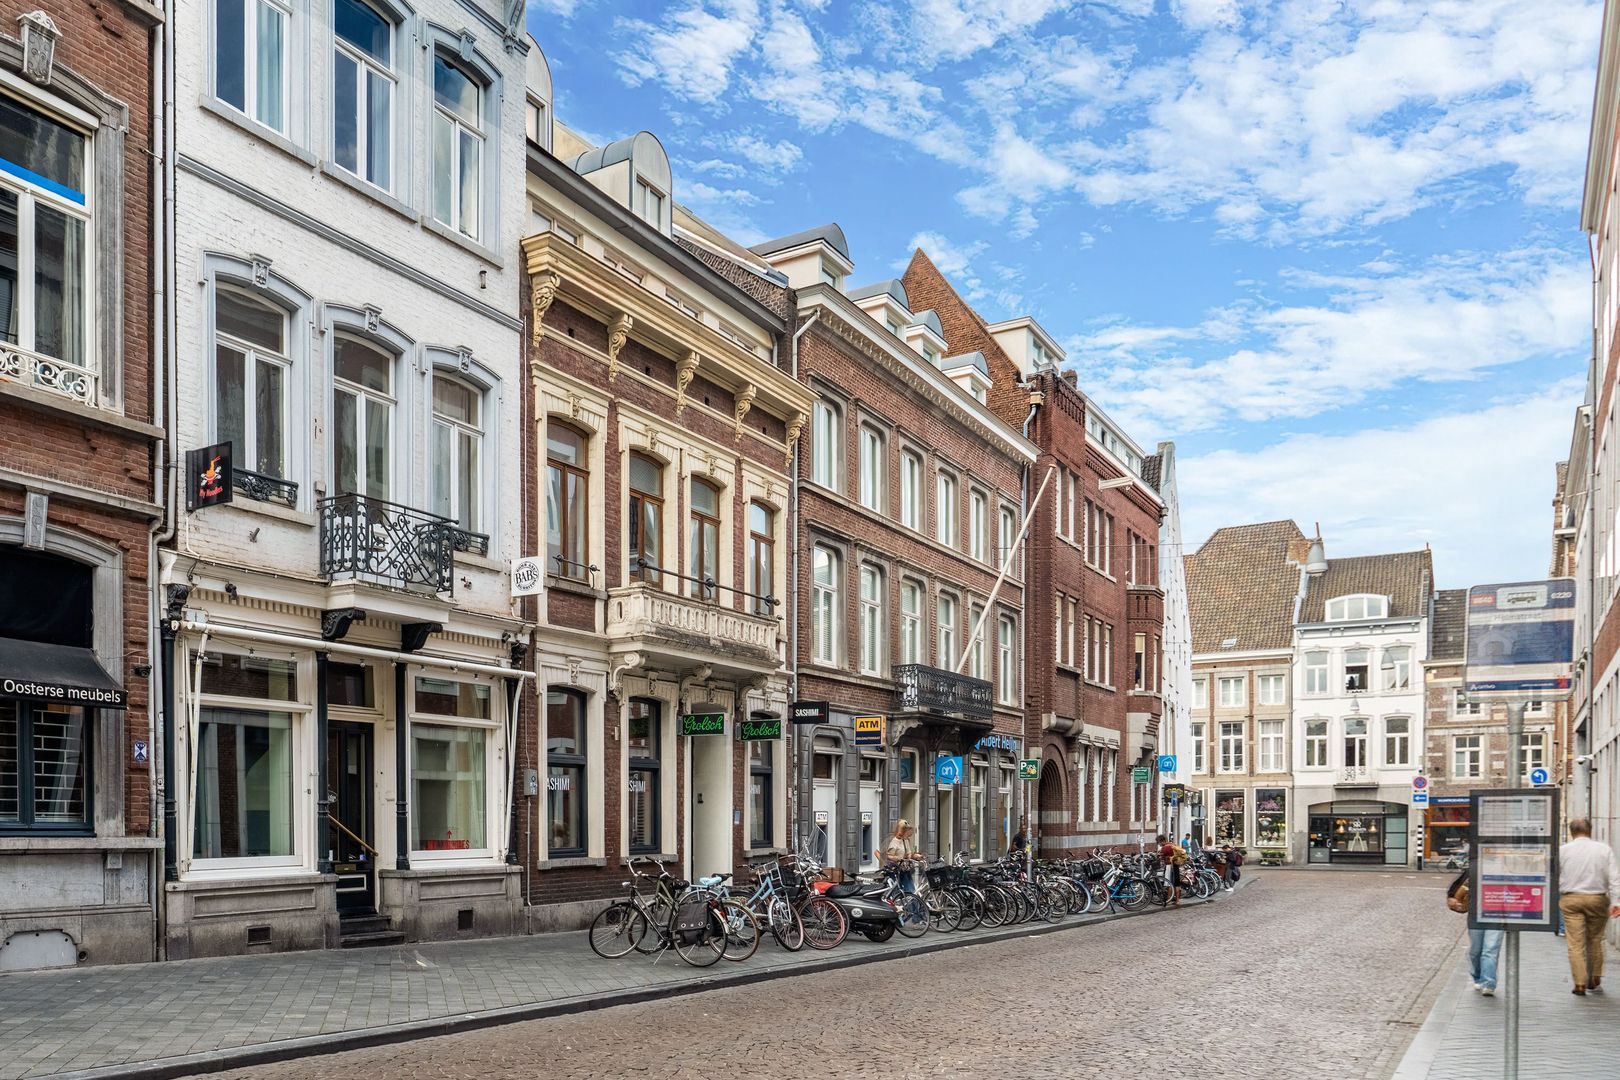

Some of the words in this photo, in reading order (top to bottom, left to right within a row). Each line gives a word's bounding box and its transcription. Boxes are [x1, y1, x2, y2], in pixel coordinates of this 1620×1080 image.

[515, 570, 538, 584] BABS
[3, 679, 64, 697] Oosterse
[67, 688, 121, 703] meubels
[795, 708, 819, 717] SASHIMI
[683, 715, 723, 735] Grolsch
[741, 722, 780, 741] Grolsch
[858, 720, 879, 729] ATM
[1020, 761, 1028, 770] P
[546, 777, 571, 791] ASHIMI
